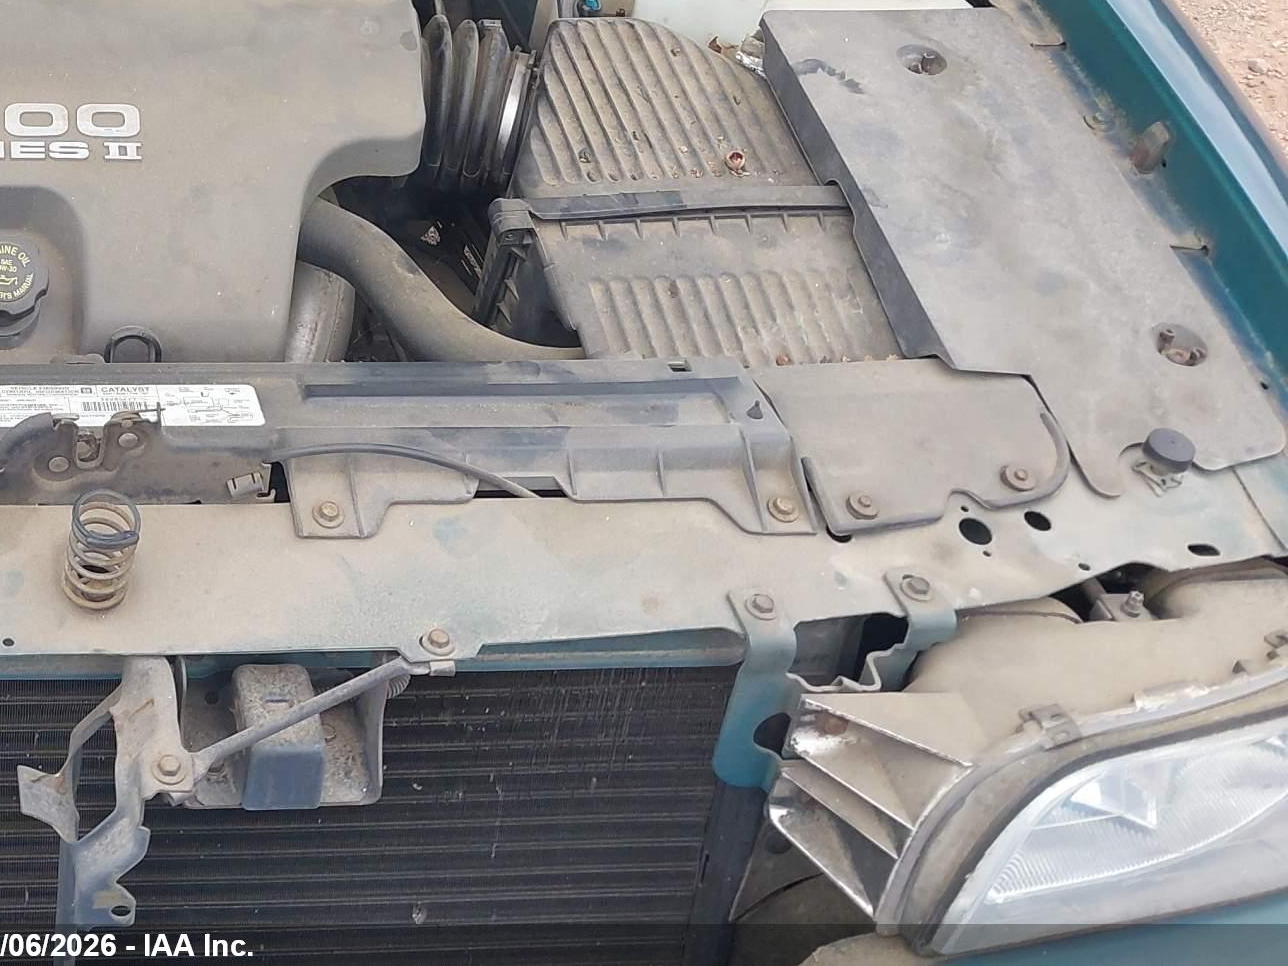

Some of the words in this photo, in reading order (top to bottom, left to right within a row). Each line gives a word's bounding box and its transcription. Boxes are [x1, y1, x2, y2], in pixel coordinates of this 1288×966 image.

[103, 141, 143, 161] II
[17, 252, 32, 267] OIL
[14, 273, 34, 298] MANUAL
